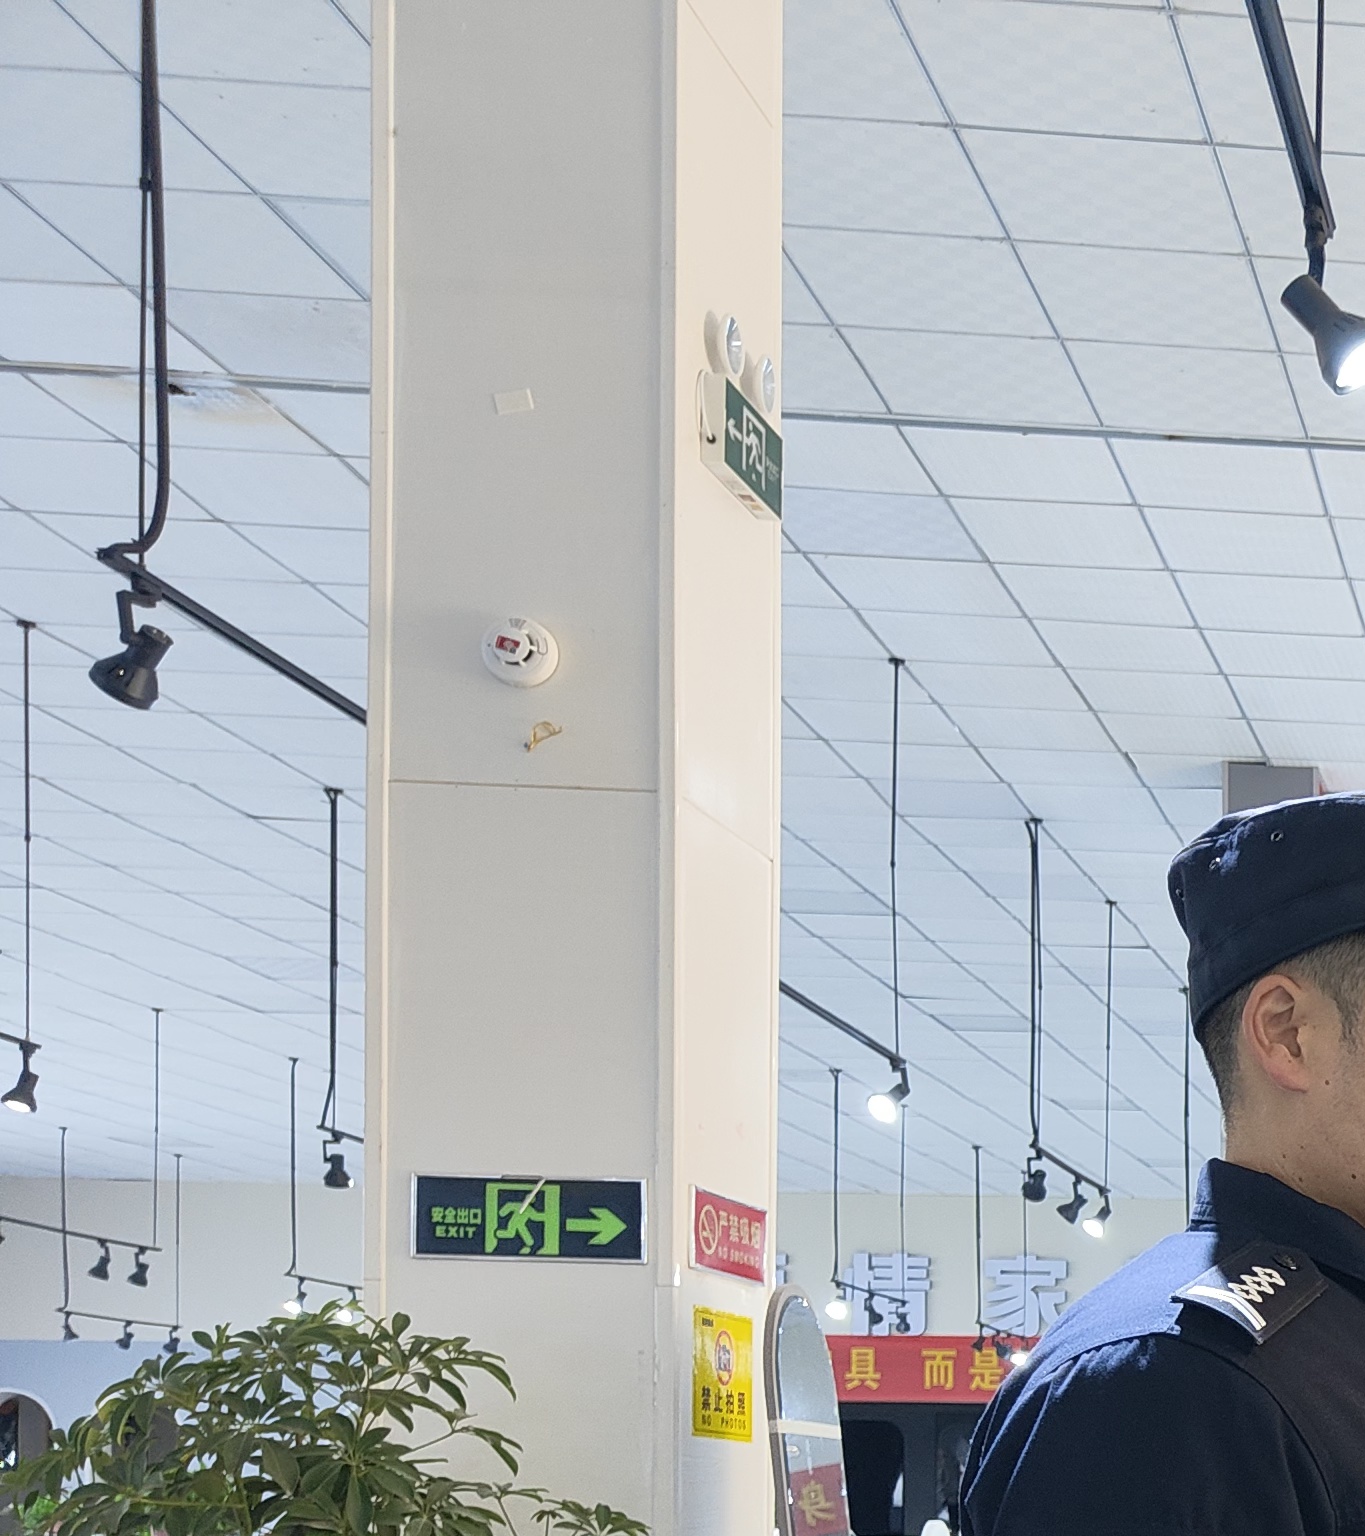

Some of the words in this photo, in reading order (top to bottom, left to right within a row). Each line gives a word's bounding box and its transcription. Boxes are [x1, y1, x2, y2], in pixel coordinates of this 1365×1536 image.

[431, 1206, 482, 1225] 安全出口
[435, 1225, 477, 1239] EXIT
[718, 1209, 761, 1250] 严禁吸烟
[844, 1346, 882, 1391] 具
[701, 1384, 747, 1417] 禁止拍照
[701, 1413, 713, 1428] NO
[720, 1416, 747, 1431] PHOTOS
